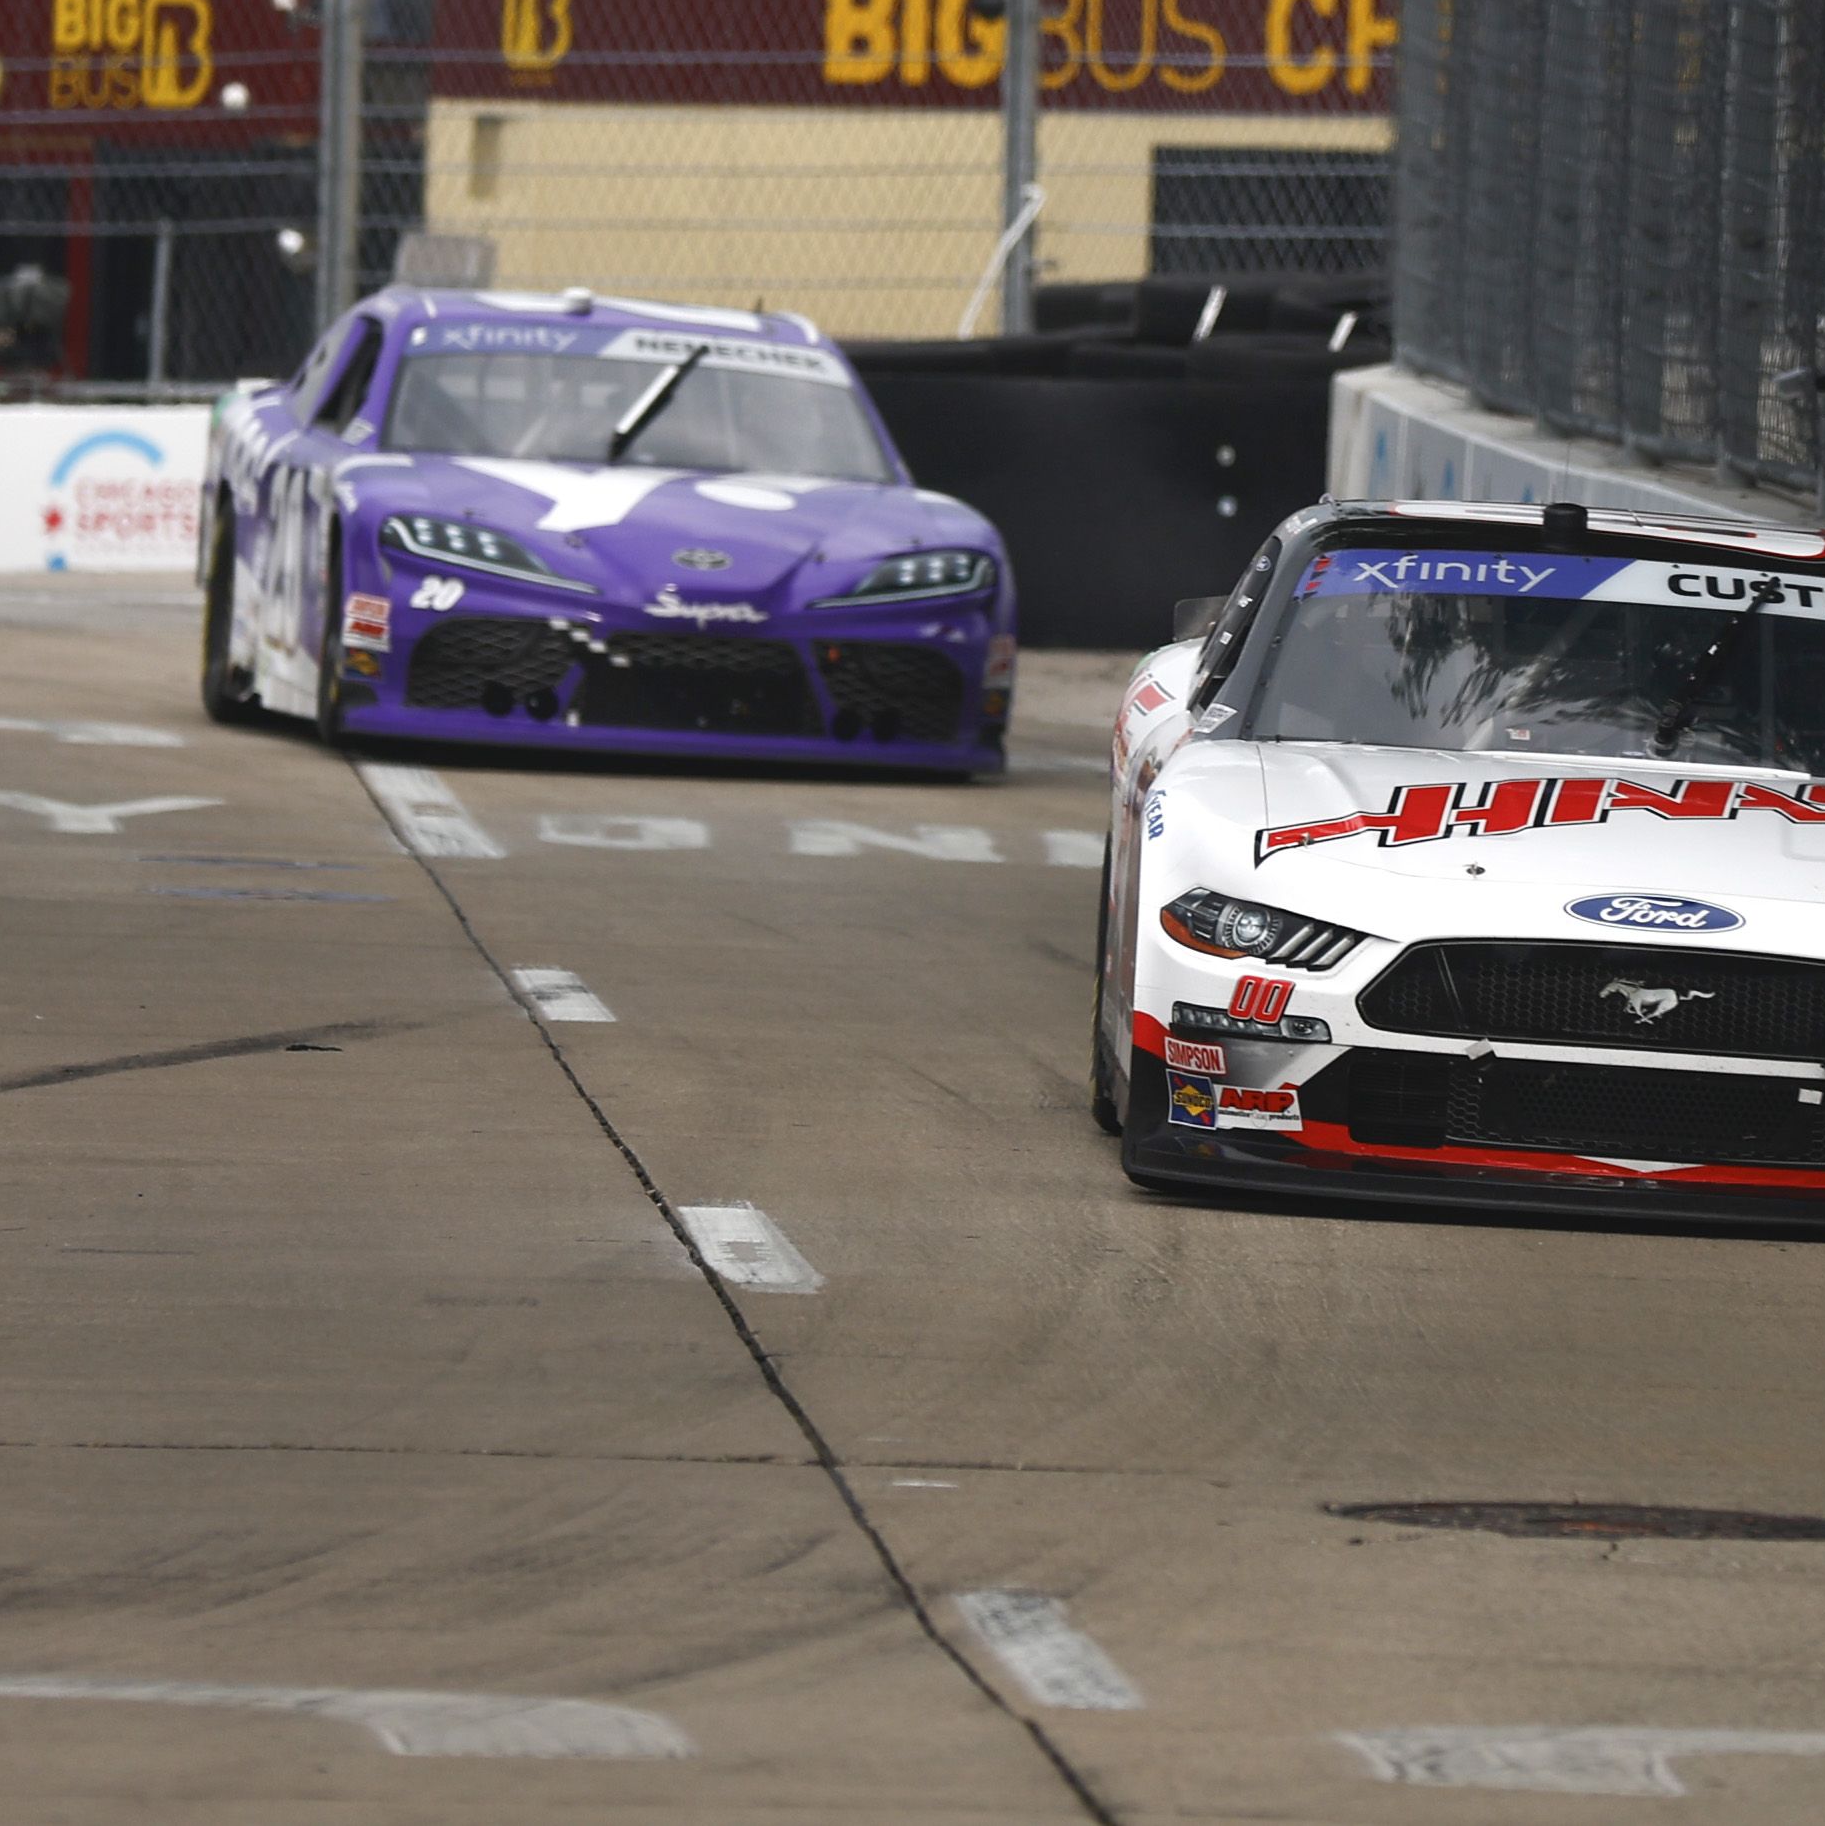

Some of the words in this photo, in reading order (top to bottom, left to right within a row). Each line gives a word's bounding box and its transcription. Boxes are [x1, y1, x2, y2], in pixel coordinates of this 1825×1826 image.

[49, 52, 142, 110] BUS
[443, 323, 578, 352] xfinity
[1352, 552, 1557, 593] xfinity
[410, 575, 465, 612] 20
[643, 583, 769, 630] Supra
[1598, 895, 1707, 932] Ford
[1227, 975, 1296, 1025] 00
[1167, 1039, 1221, 1072] SIMPSON
[1219, 1087, 1295, 1113] ARP
